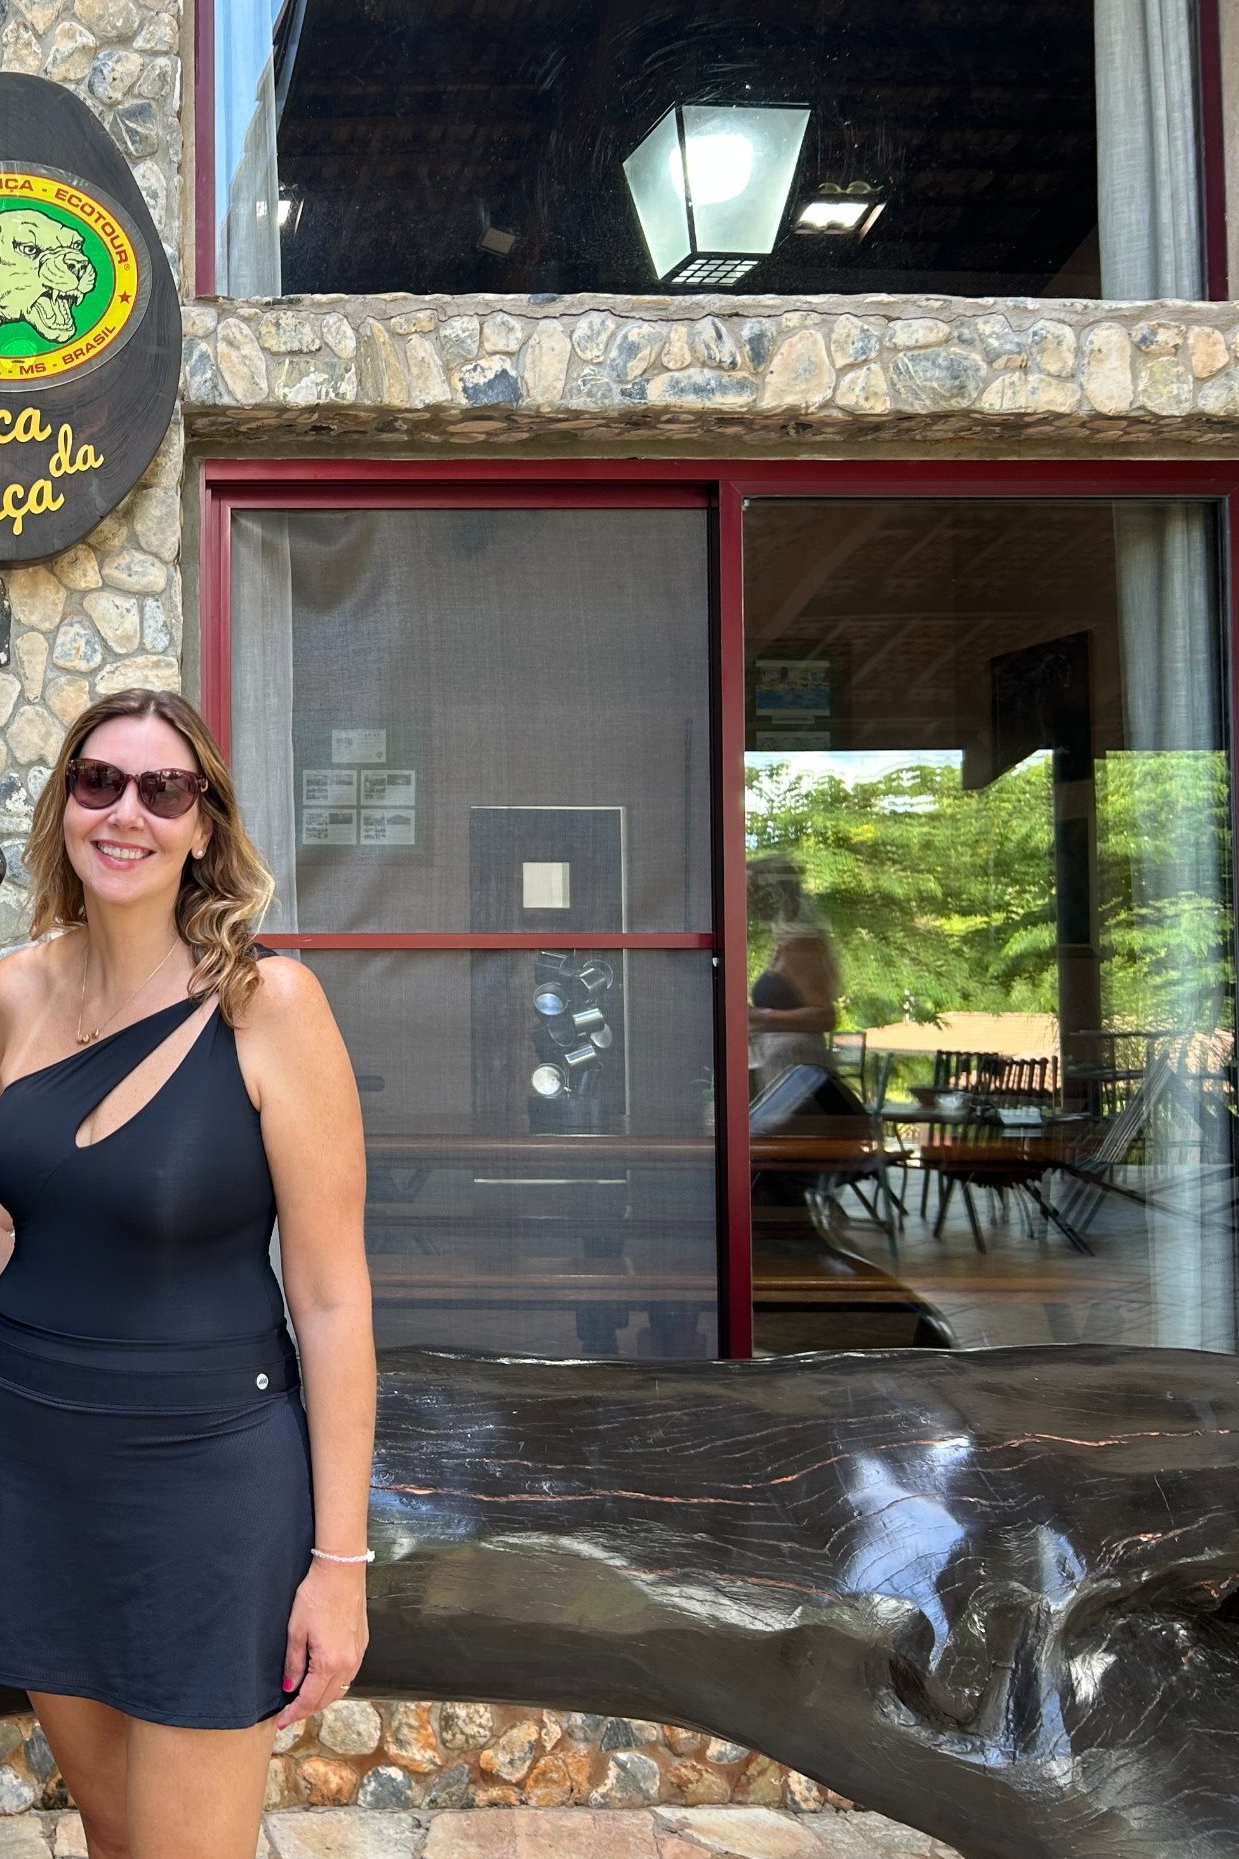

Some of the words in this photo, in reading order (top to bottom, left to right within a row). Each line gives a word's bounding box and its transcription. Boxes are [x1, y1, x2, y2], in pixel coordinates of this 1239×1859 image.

[19, 362, 47, 375] MS
[62, 325, 116, 366] BRASIL
[49, 424, 104, 478] da
